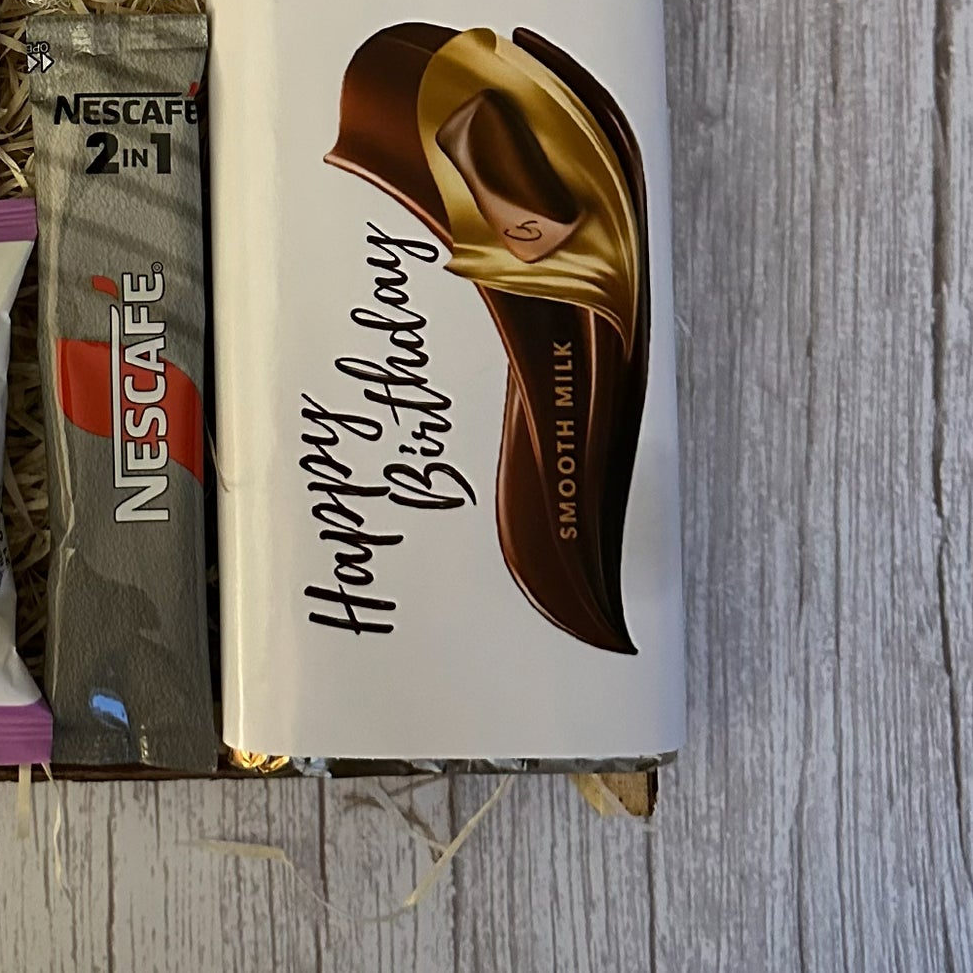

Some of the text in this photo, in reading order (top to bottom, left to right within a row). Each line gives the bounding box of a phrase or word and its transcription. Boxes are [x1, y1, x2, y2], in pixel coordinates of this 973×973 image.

[335, 222, 477, 509] Birthday
[553, 340, 577, 540] SMOOTH MILK
[299, 393, 404, 635] Happy
